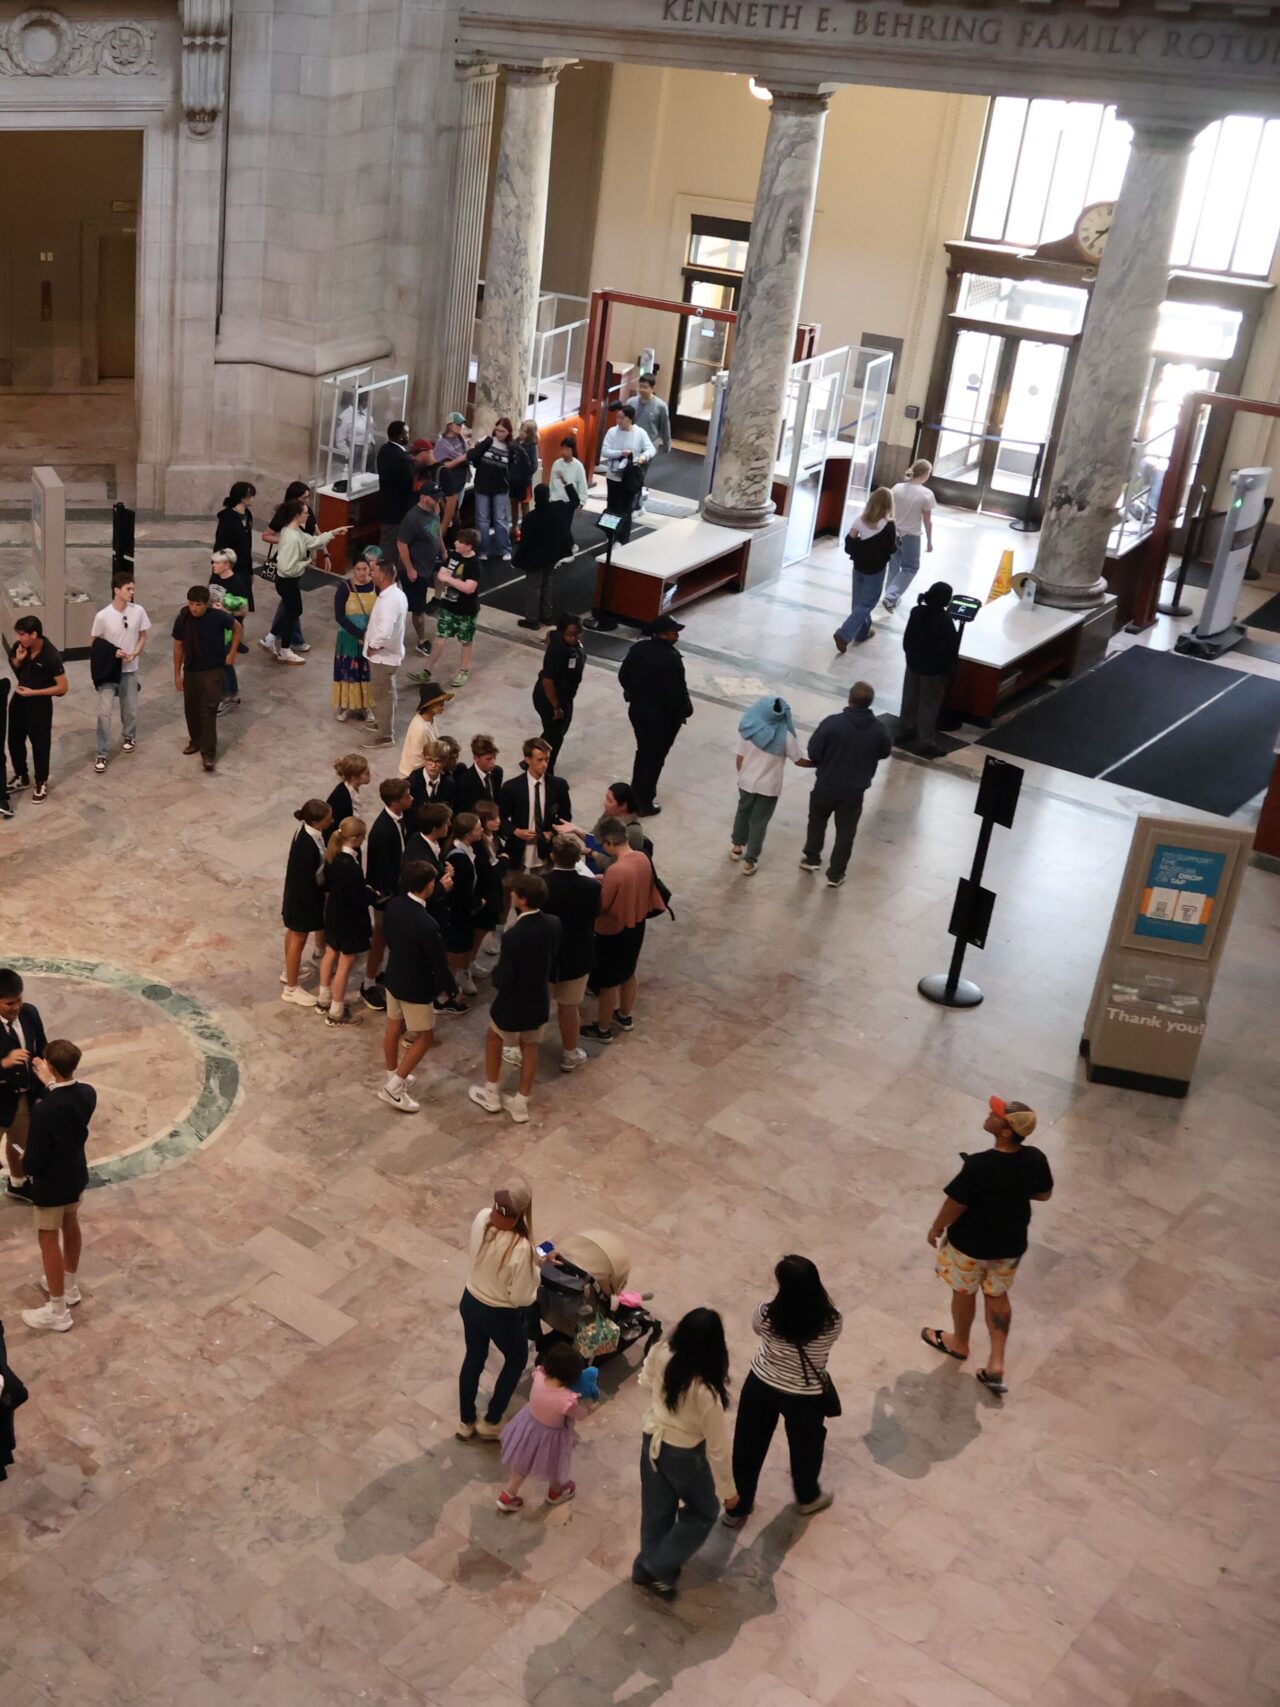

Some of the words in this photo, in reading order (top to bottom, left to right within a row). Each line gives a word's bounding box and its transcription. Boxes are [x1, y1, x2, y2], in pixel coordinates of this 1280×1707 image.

[662, 0, 803, 30] KENNETH
[815, 8, 838, 33] E.
[852, 9, 1002, 45] BEHRING
[1017, 21, 1149, 55] FAMILY
[1160, 30, 1280, 65] ROTU
[1107, 1007, 1162, 1028] Thank
[1166, 1021, 1206, 1035] you!
